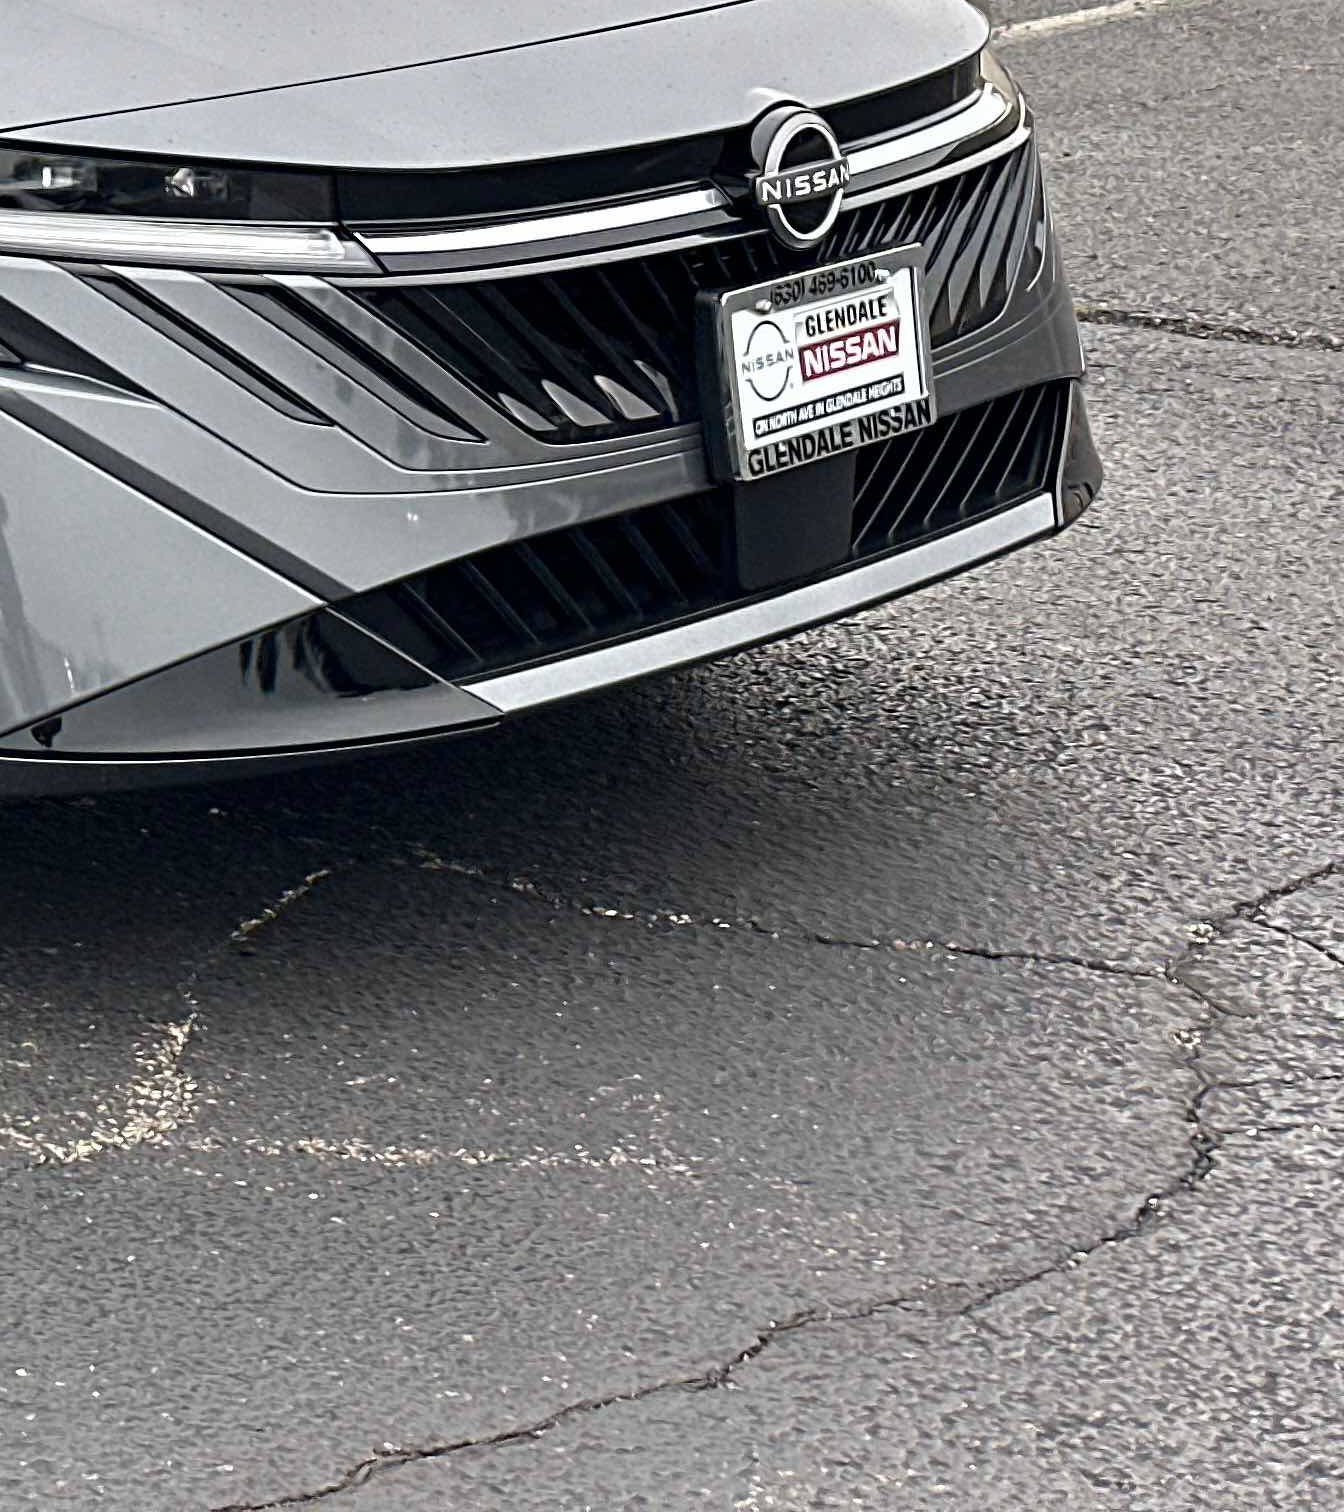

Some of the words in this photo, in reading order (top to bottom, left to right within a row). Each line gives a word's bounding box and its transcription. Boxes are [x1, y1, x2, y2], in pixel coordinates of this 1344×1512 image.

[761, 164, 850, 202] NISSAN
[805, 294, 888, 337] GLENDALE
[741, 347, 795, 375] NISSAN
[803, 325, 898, 377] NISSAN
[769, 411, 798, 431] NORTH
[798, 406, 814, 421] AVE
[825, 388, 867, 412] GLENDALE
[868, 377, 903, 400] HEIGHTS
[748, 420, 854, 477] GLENDALE
[857, 397, 932, 441] NISSAN
